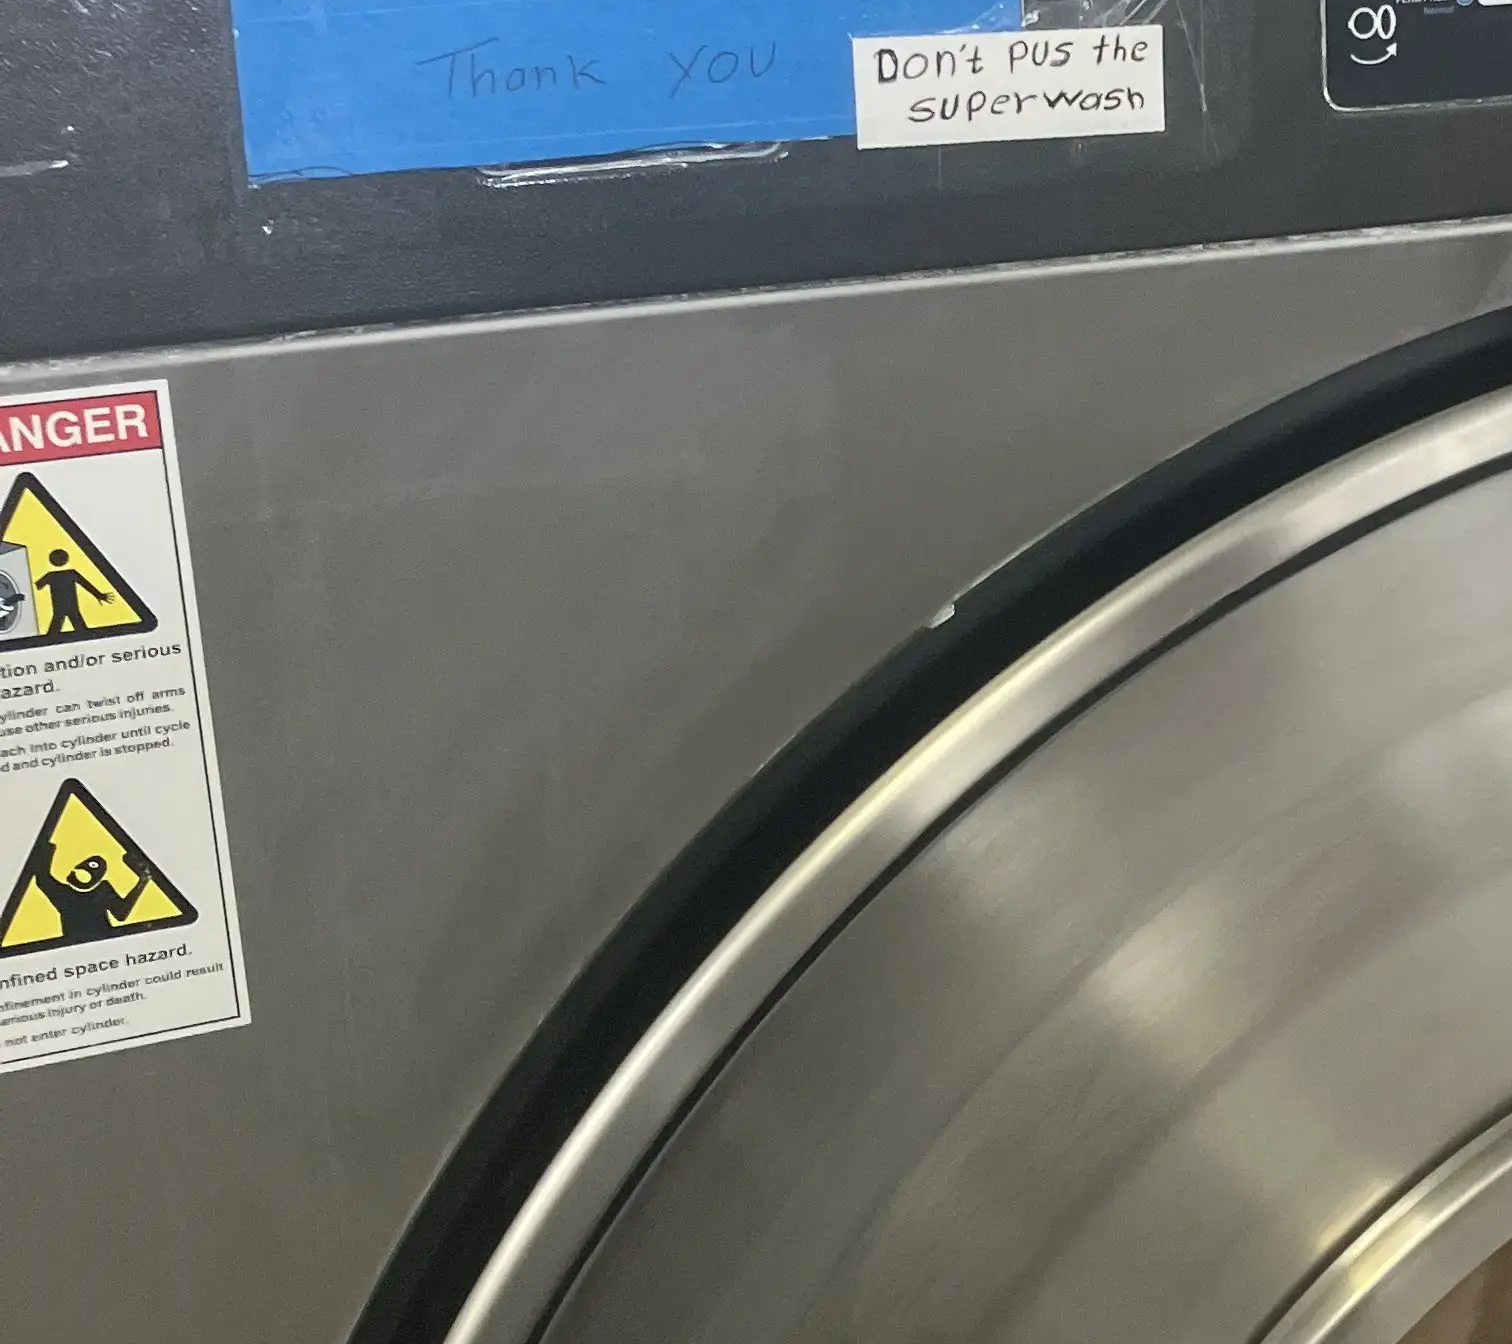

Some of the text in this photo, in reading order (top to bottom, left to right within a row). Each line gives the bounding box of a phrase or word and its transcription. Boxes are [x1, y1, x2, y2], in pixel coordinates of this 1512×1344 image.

[876, 45, 984, 84] Don't
[1094, 34, 1148, 64] the
[44, 654, 106, 673] and/or
[112, 643, 181, 663] serious
[56, 687, 185, 714] can twist off arms
[25, 720, 62, 733] other
[64, 711, 116, 727] serious
[31, 720, 190, 751] into cylinder until cycle
[13, 758, 39, 771] and
[42, 749, 96, 767] cylinder
[64, 958, 119, 979] space
[125, 943, 192, 967] hazard.
[87, 962, 224, 997] cylinder could result
[31, 1028, 67, 1041] enter
